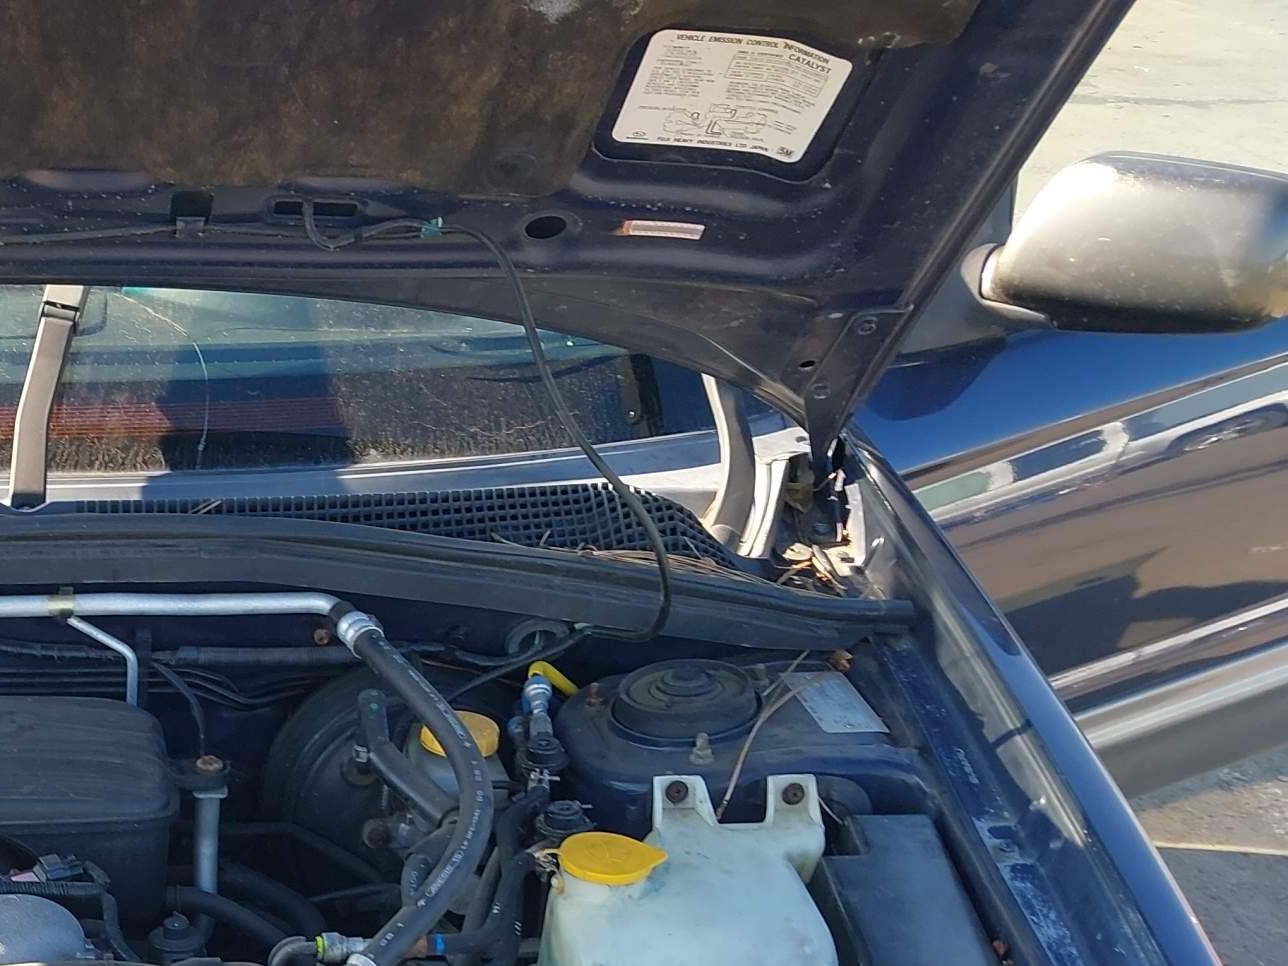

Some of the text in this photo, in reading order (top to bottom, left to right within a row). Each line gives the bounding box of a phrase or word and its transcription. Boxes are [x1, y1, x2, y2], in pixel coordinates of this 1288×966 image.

[676, 33, 706, 43] VEHICLE
[708, 35, 743, 45] EMISSION
[746, 38, 779, 48] CONTROL
[783, 40, 830, 64] INFORMATION
[788, 52, 832, 75] CATALYST
